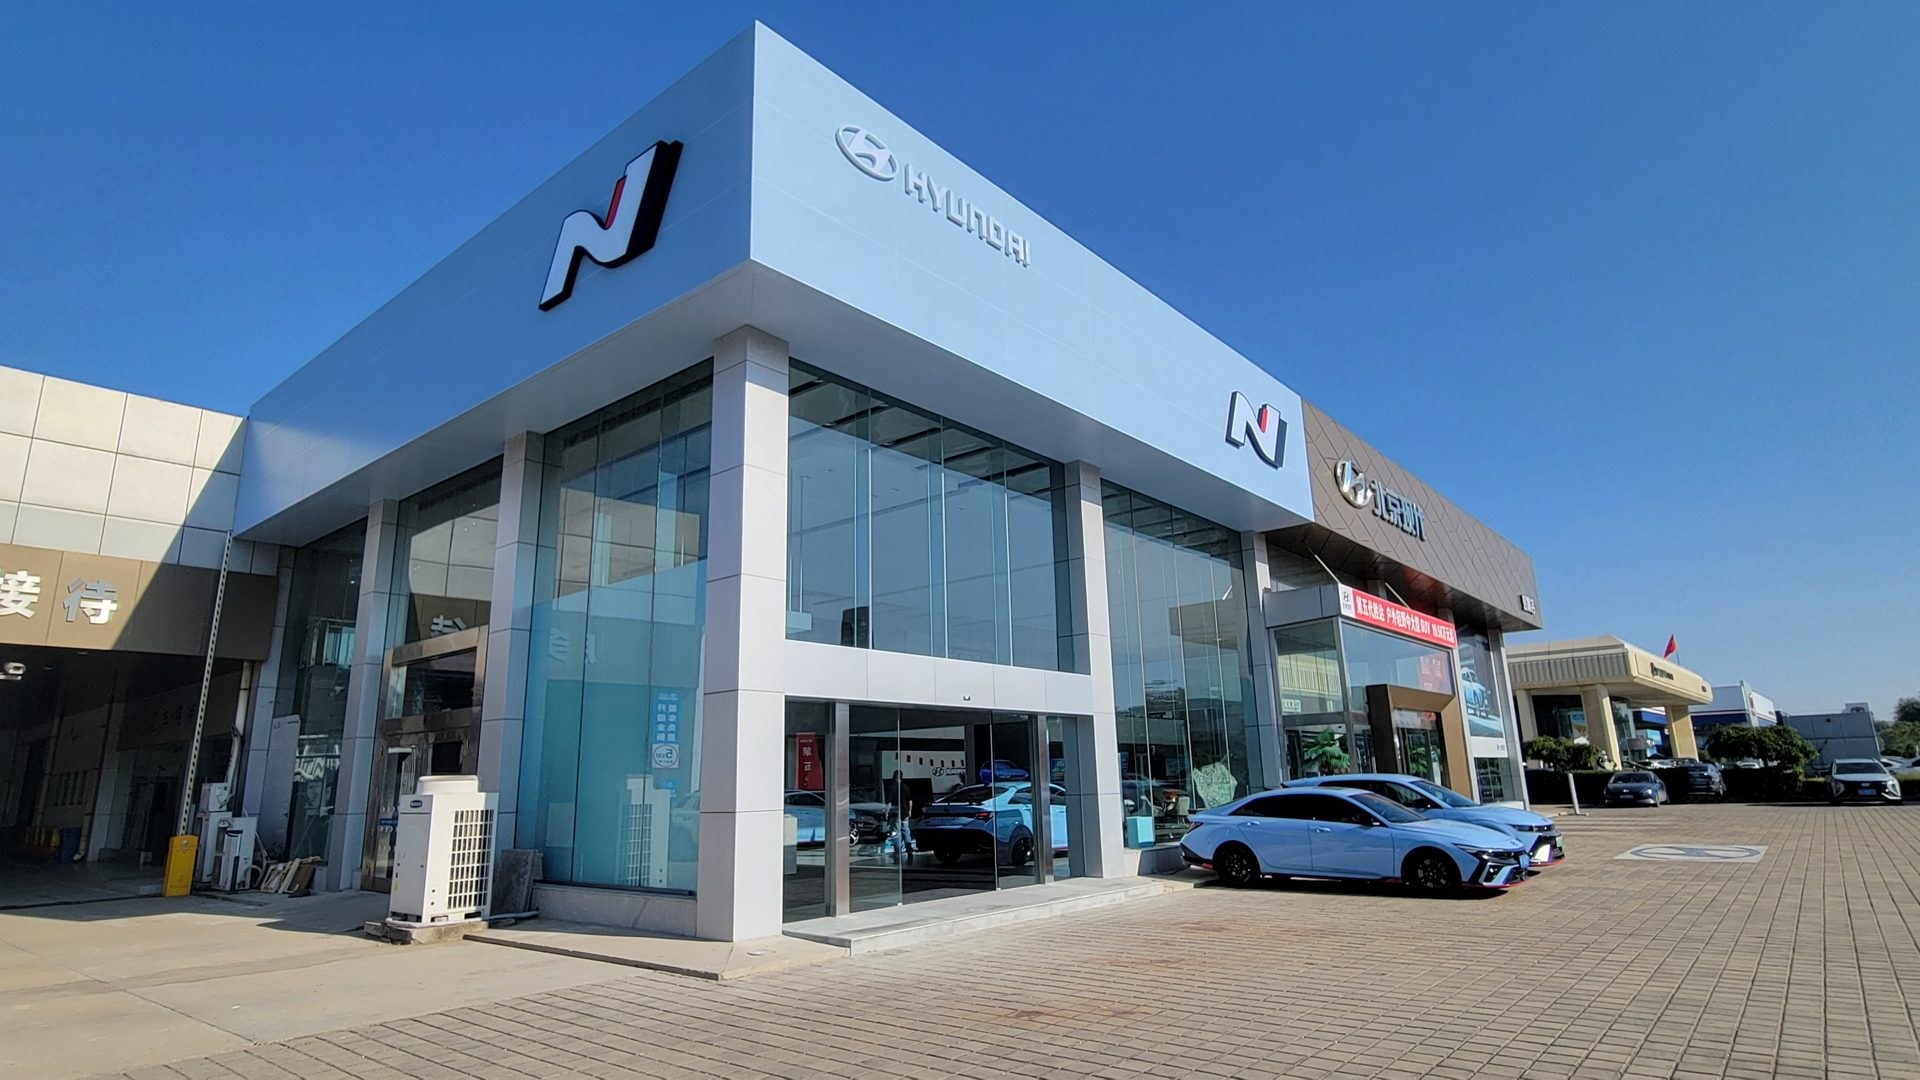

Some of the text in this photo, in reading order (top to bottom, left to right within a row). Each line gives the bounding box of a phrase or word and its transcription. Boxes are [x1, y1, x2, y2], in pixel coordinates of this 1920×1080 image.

[538, 139, 684, 312] N
[904, 162, 1031, 267] HYUNDAI
[1225, 391, 1287, 471] N
[1369, 480, 1427, 541] 北京现代
[0, 568, 118, 625] 接待
